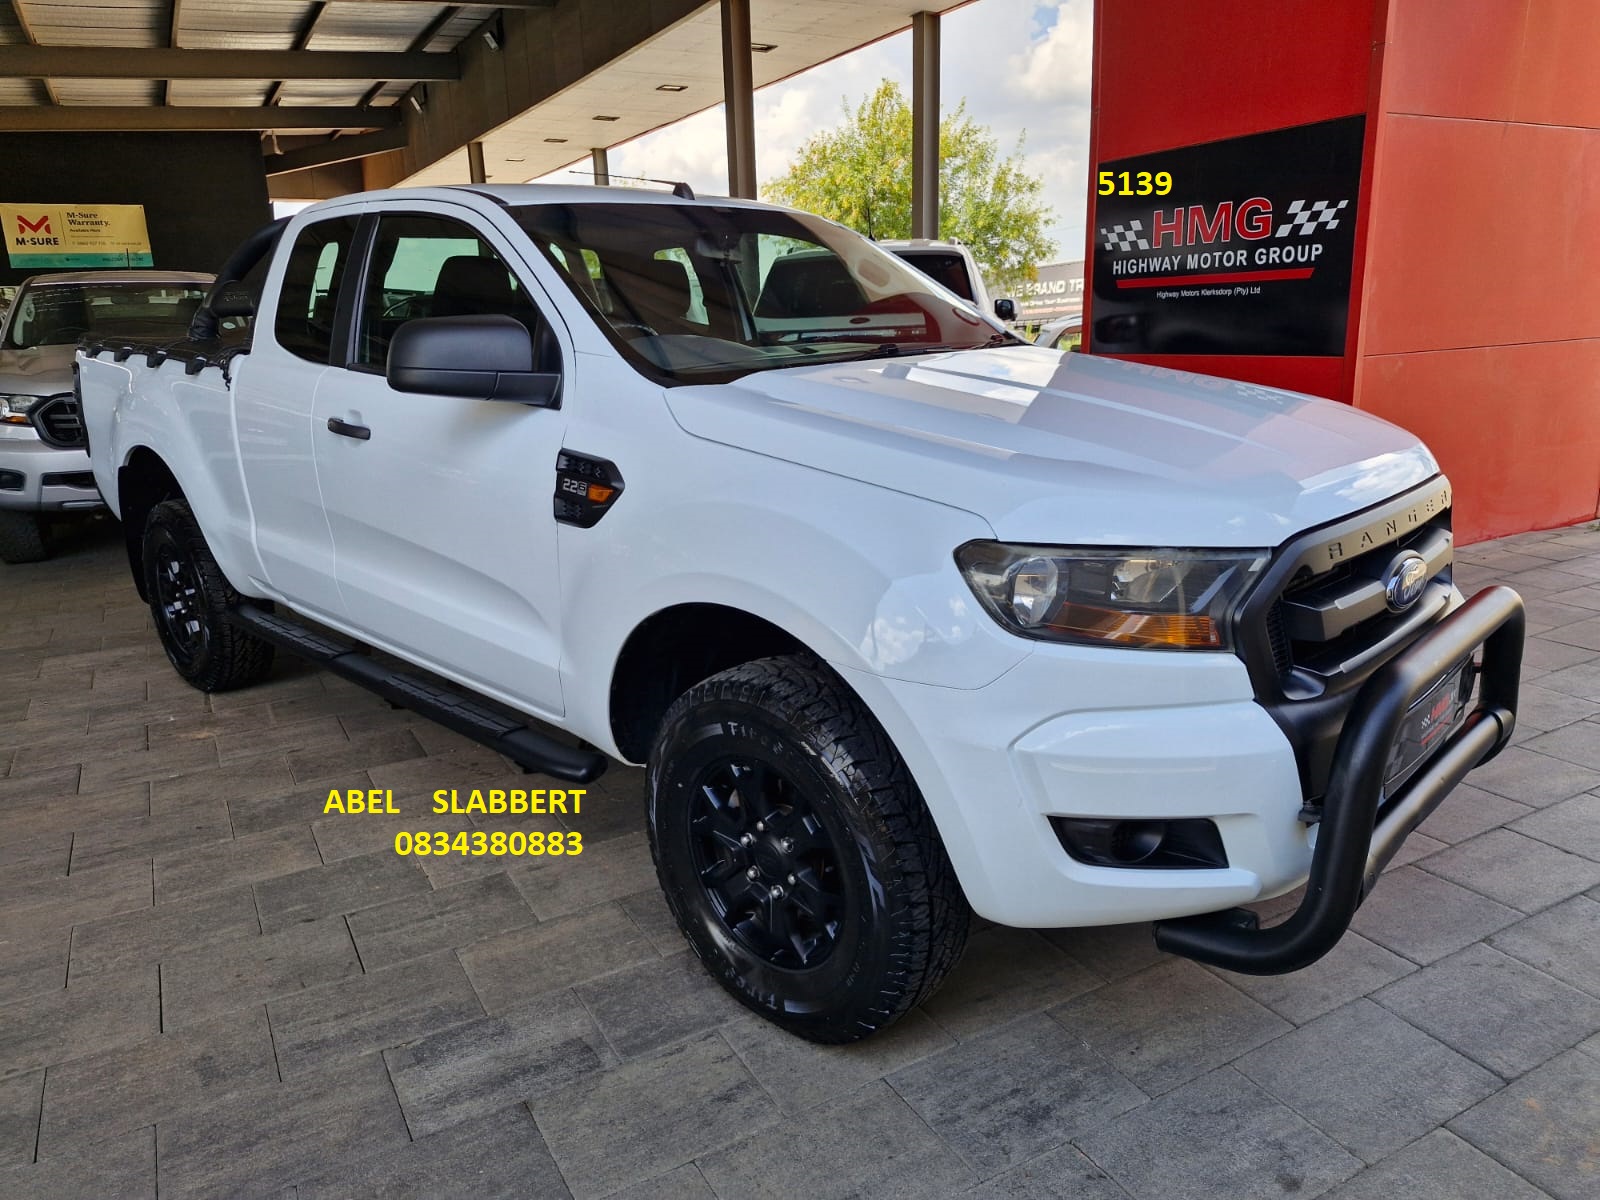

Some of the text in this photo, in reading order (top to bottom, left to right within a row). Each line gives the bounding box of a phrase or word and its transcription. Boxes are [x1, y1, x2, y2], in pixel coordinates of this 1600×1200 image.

[67, 219, 111, 227] Warranty.
[1152, 197, 1273, 249] HMG
[1112, 244, 1323, 276] HIGHWAY MOTOR GROUP
[1156, 285, 1261, 300] Highway Motors Klerksdorp (Pty) Ltd
